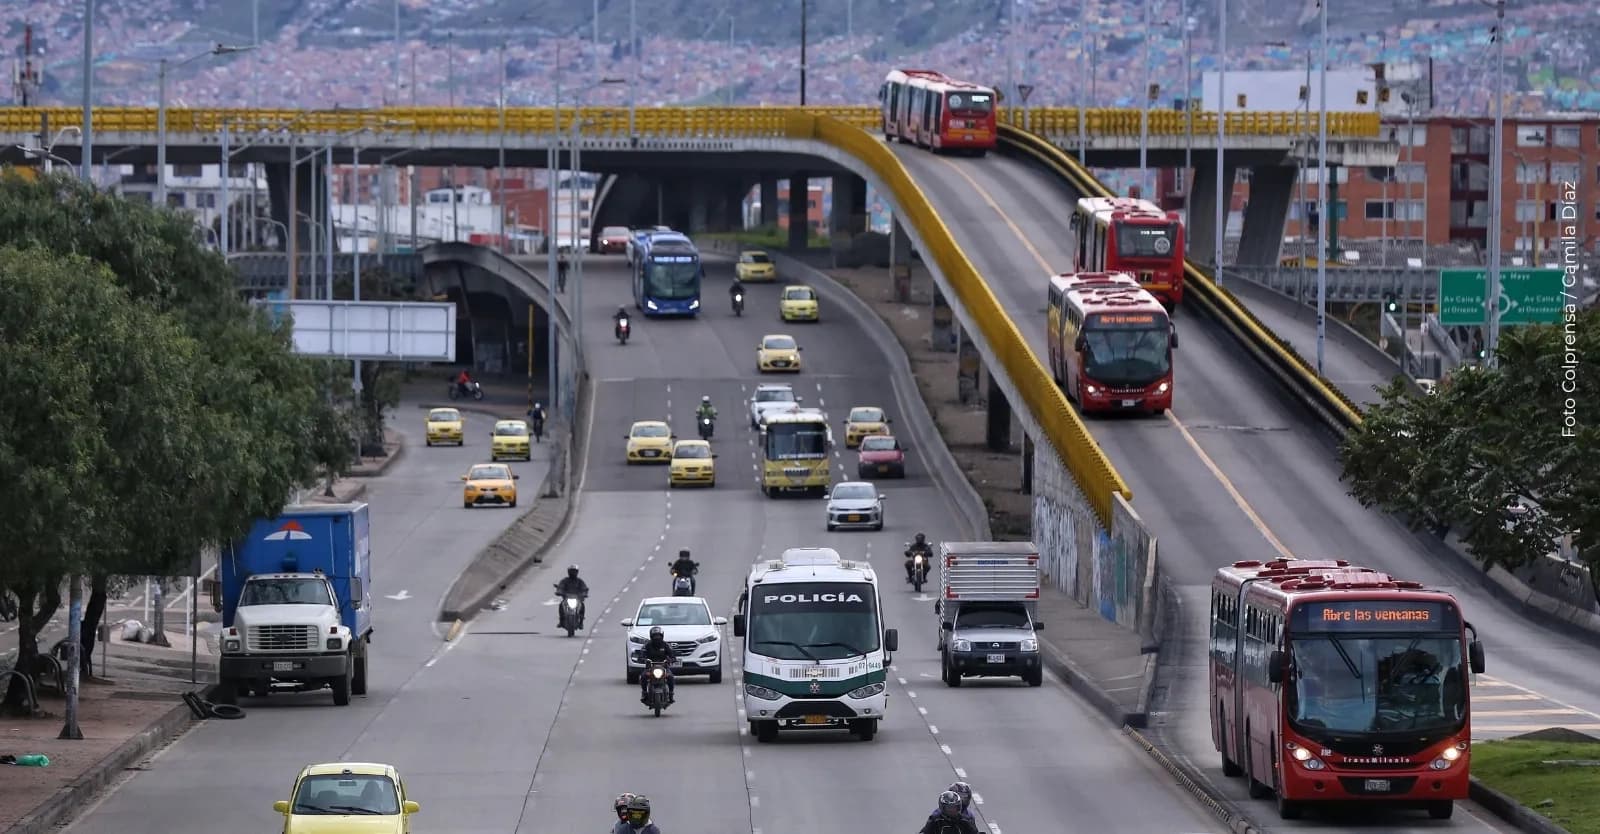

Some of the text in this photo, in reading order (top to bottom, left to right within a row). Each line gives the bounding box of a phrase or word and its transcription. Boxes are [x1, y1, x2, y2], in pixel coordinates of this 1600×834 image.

[764, 592, 863, 603] POLICÍA
[1323, 608, 1429, 621] Abre las ventanas
